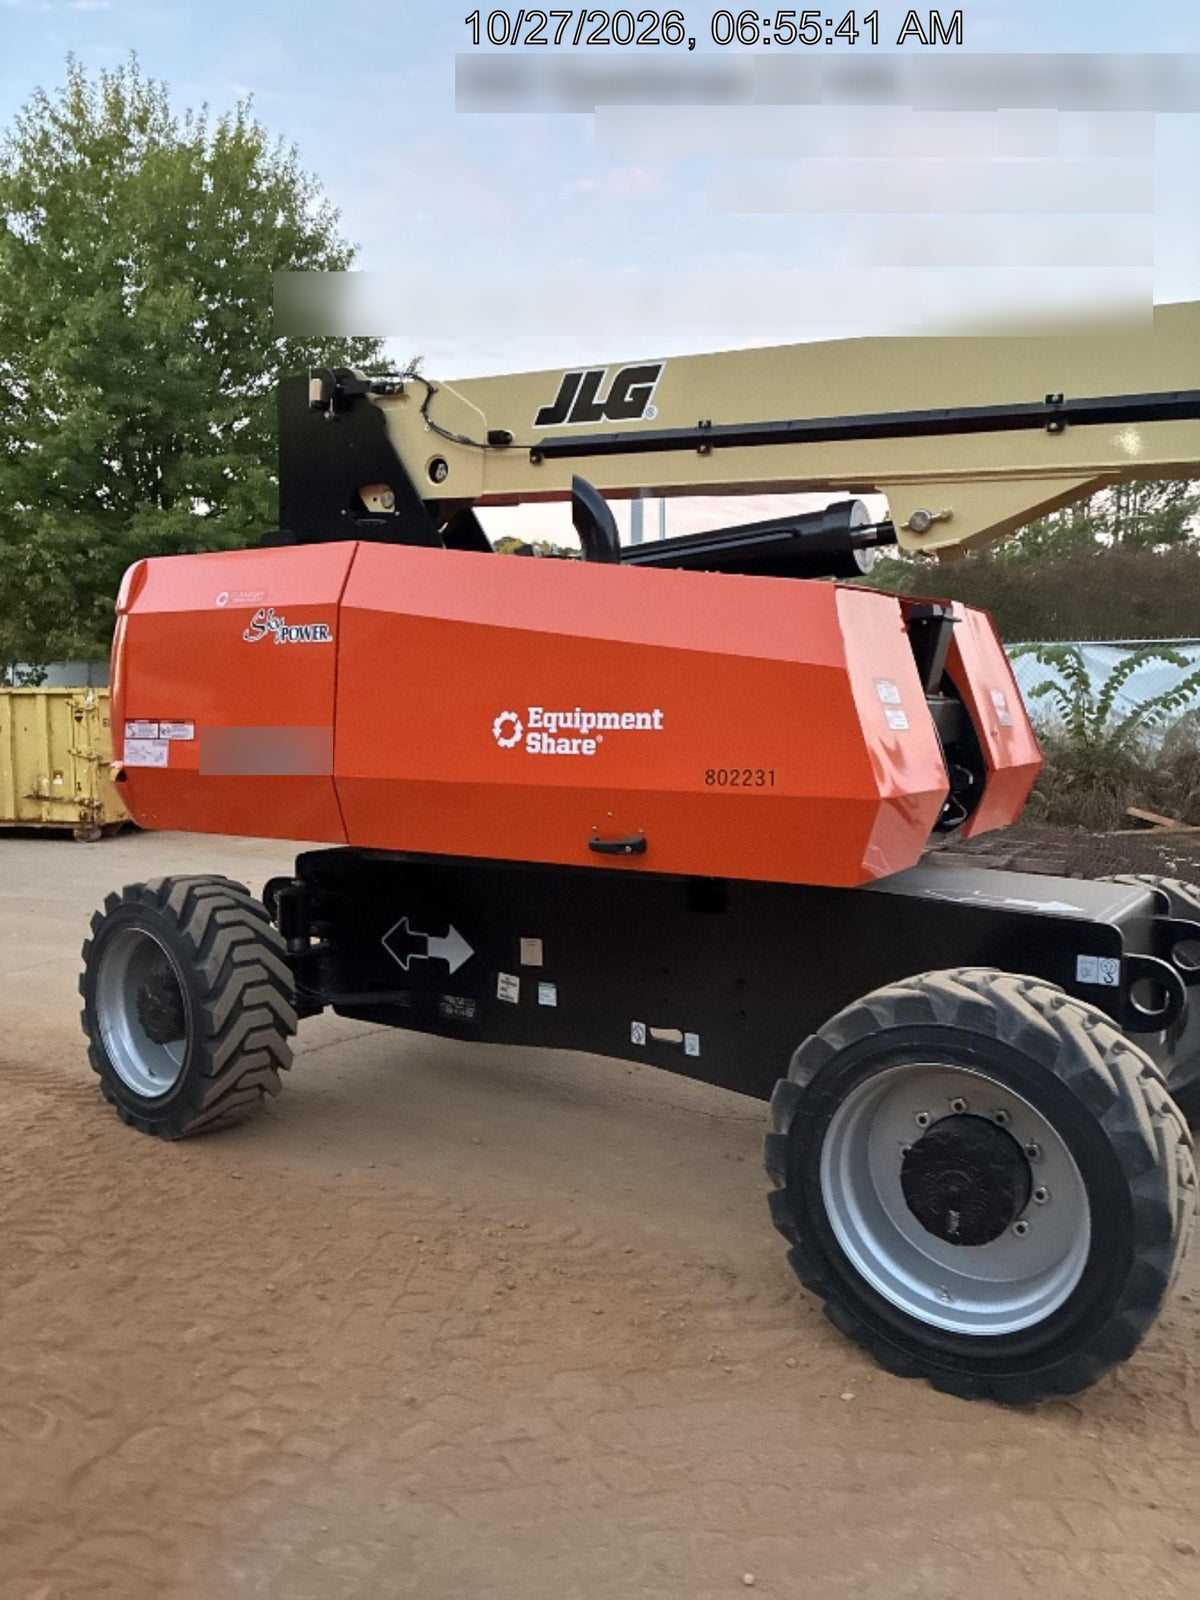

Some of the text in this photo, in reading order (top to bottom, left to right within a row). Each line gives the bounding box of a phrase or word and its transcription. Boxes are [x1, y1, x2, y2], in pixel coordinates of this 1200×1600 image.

[534, 364, 663, 426] JLG
[527, 707, 664, 733] Equipment
[705, 769, 775, 786] 802231
